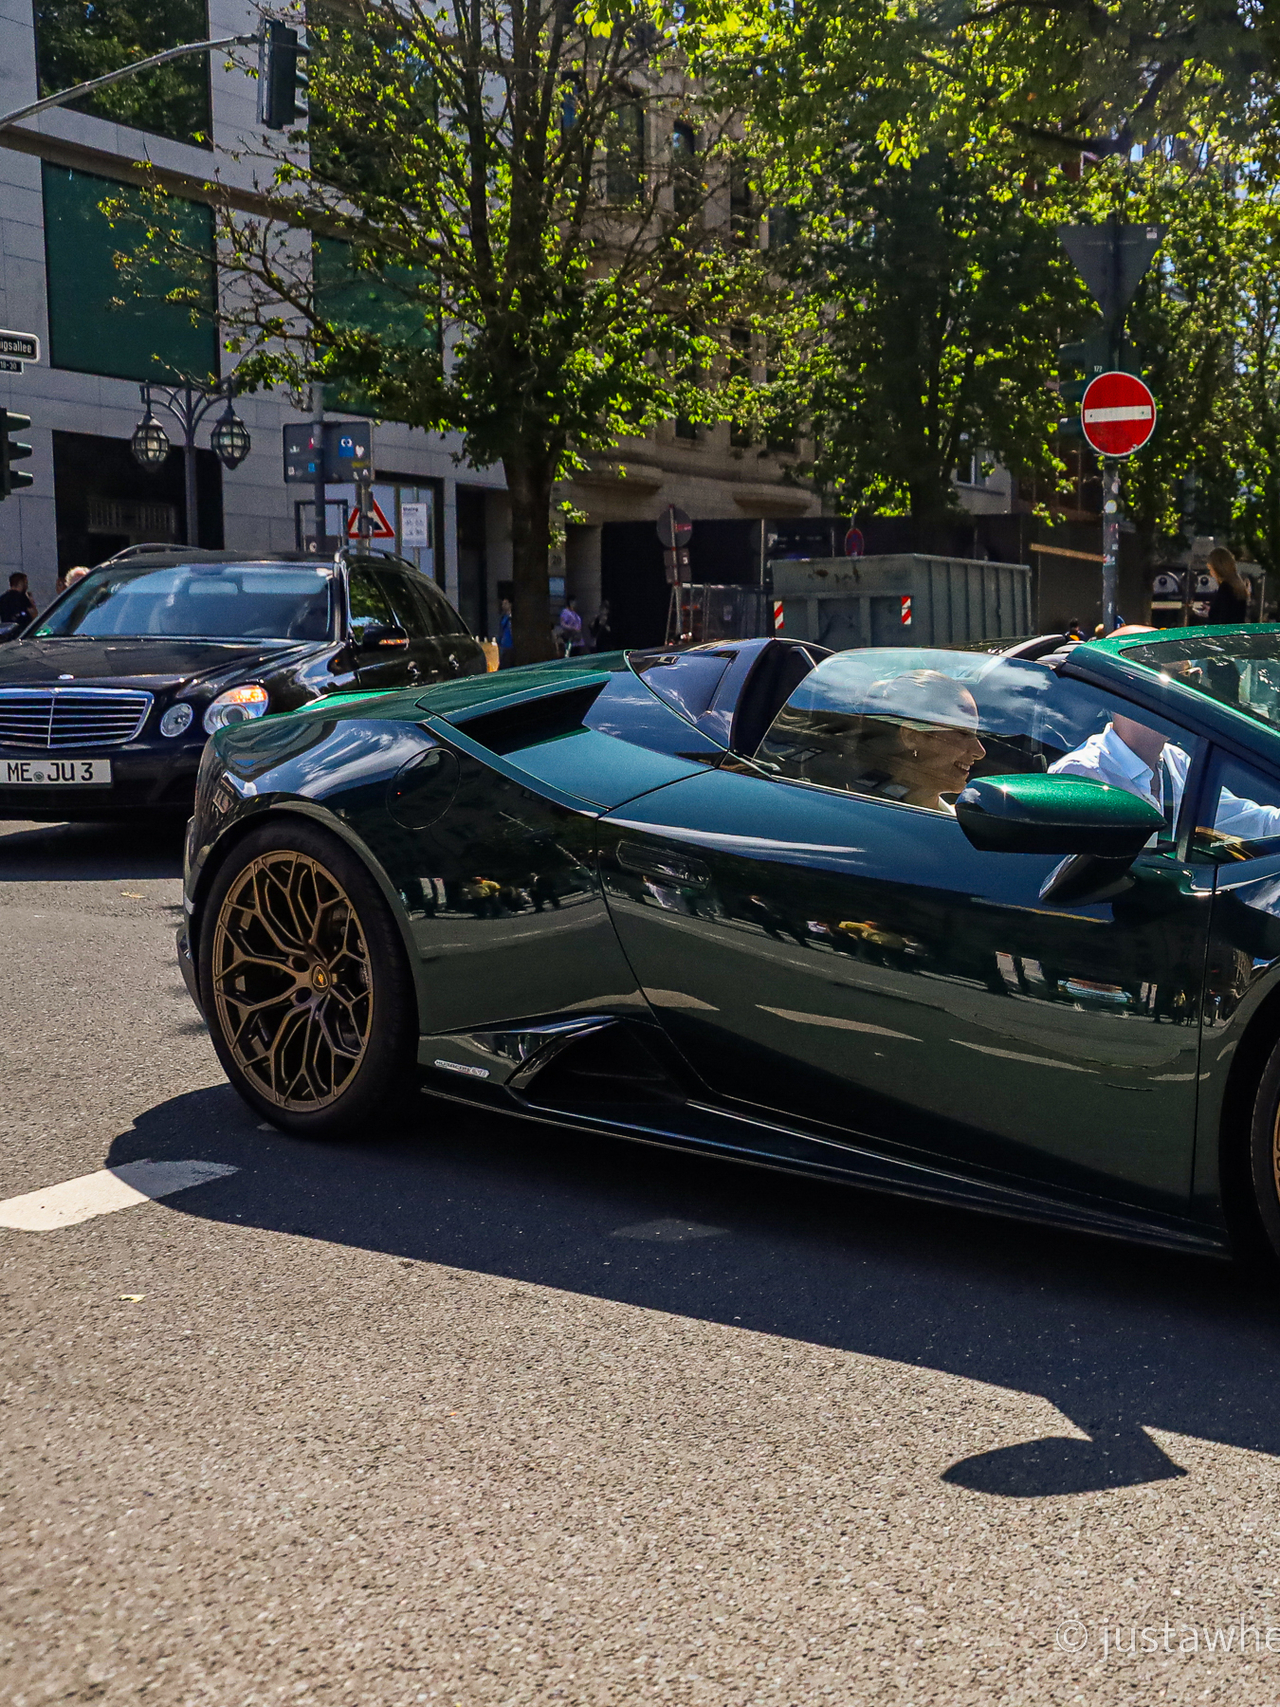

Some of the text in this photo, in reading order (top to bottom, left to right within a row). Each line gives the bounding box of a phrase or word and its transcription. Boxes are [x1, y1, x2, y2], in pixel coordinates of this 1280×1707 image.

[0, 337, 32, 354] igsallee
[7, 762, 94, 782] ME JU 3
